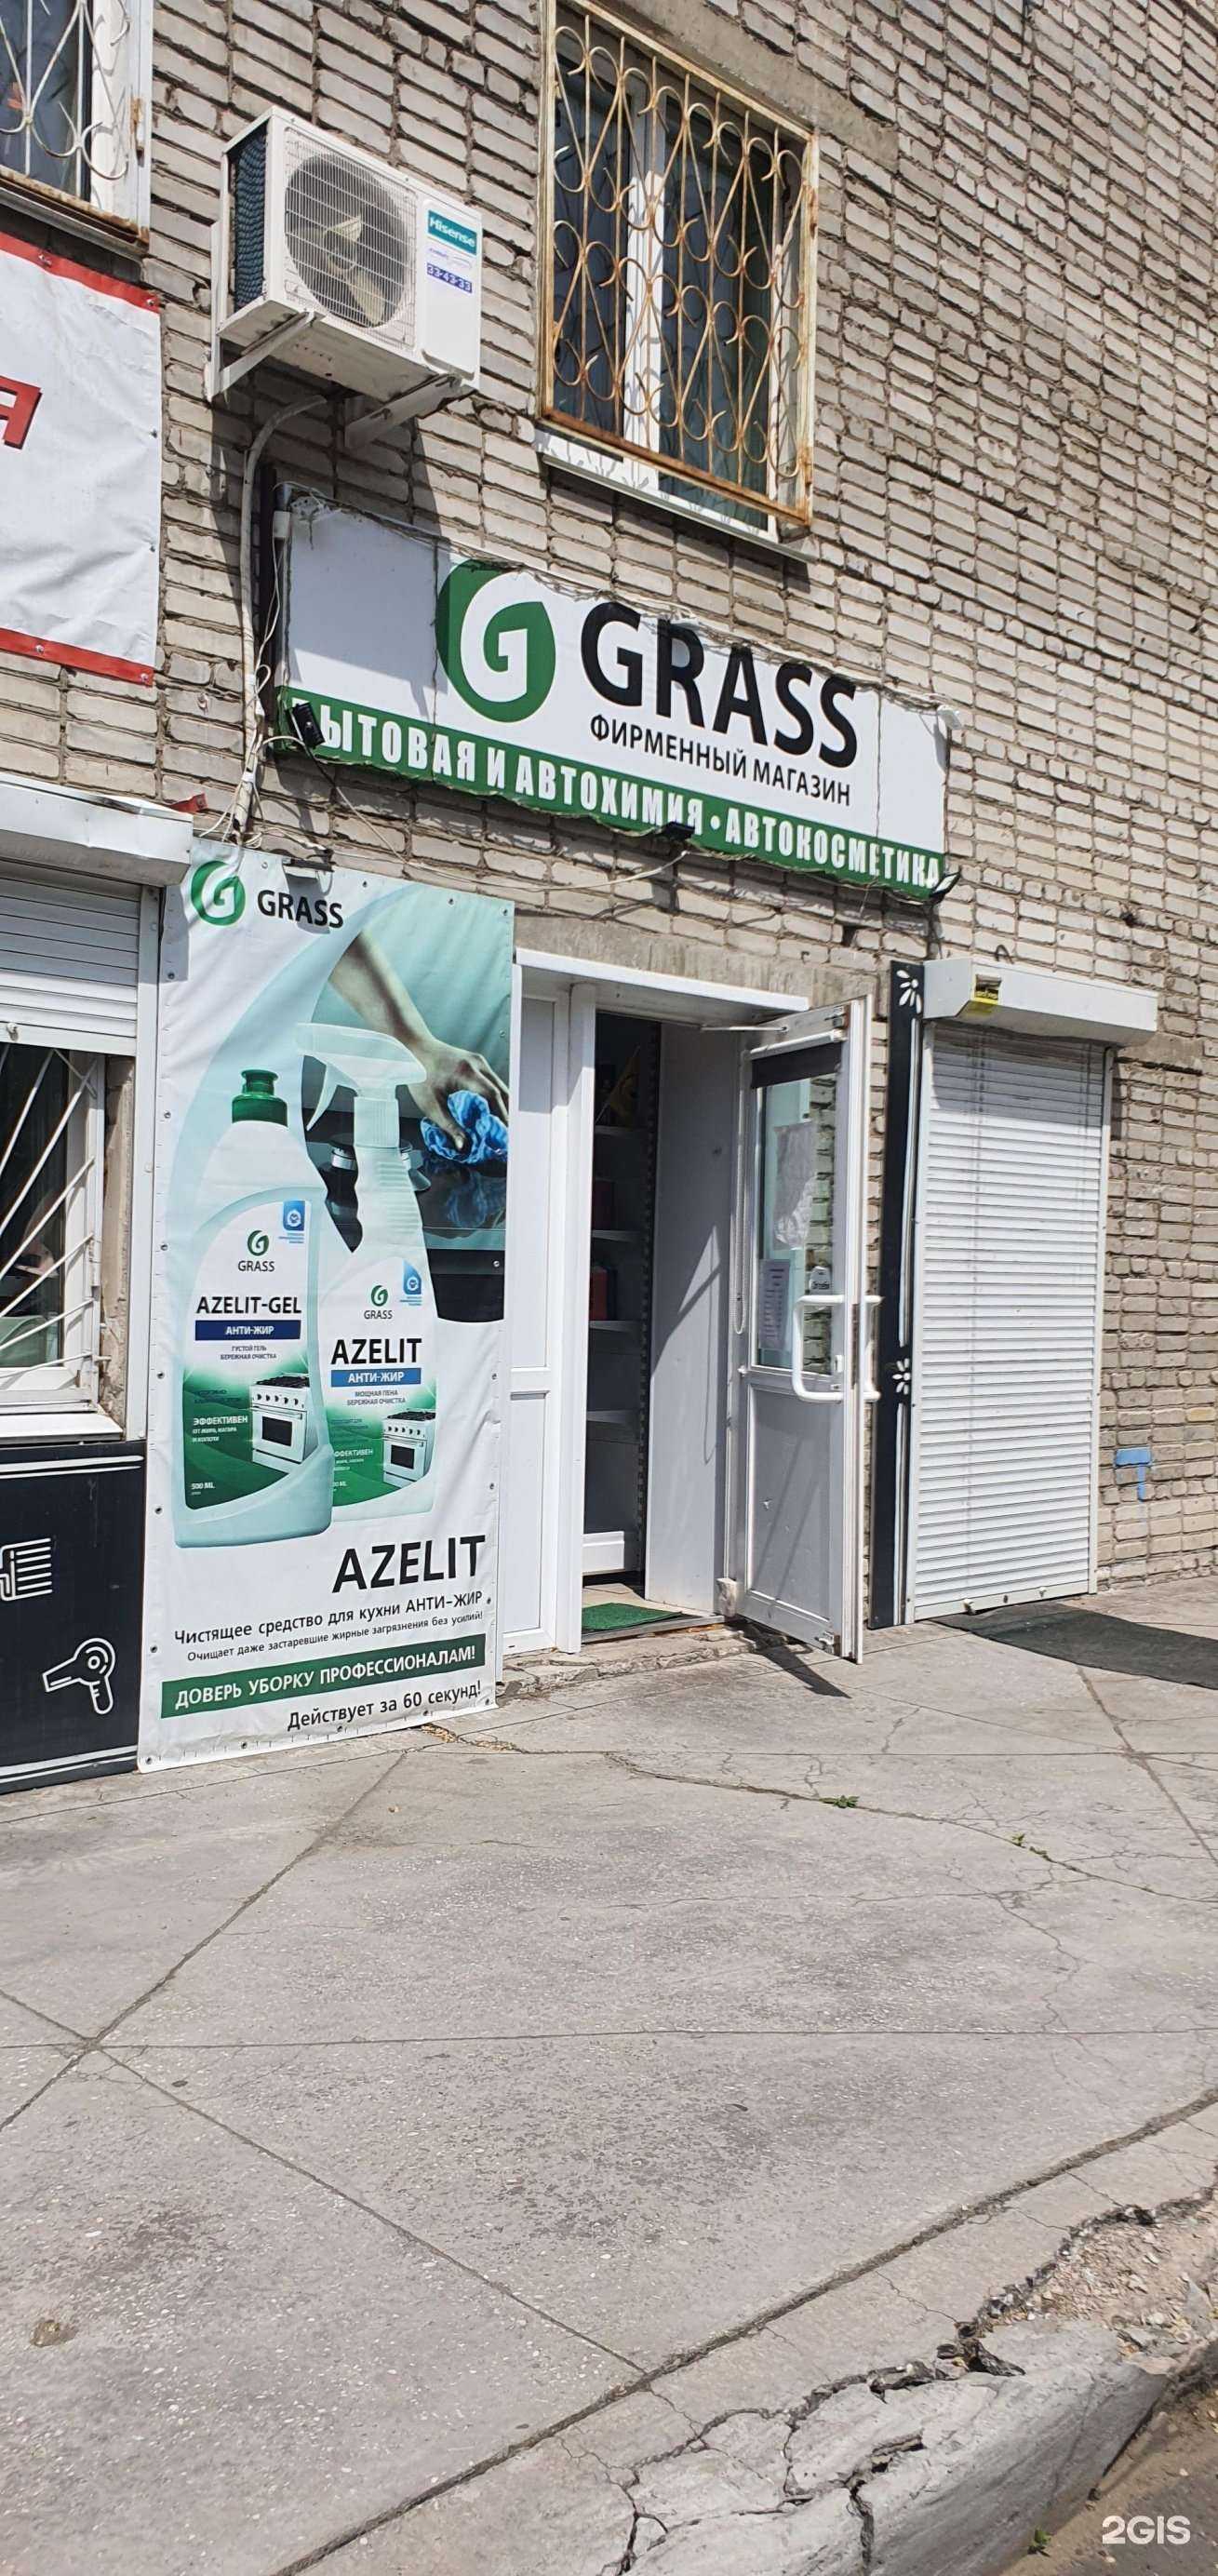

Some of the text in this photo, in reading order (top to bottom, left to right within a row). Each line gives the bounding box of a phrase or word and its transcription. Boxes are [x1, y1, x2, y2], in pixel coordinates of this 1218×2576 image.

[430, 216, 475, 248] Hisense
[581, 602, 858, 769] GRASS
[590, 713, 850, 807] ФИРМЕННЫЙ МАГАЗИН
[291, 696, 941, 889] ЫТОВАЯ И АВТОХИМИЯ АВТОКОСМЕТИКА
[257, 889, 344, 929] GRASS
[237, 1260, 275, 1272] GRASS
[196, 1296, 302, 1314] AZELIT-GEL
[364, 1309, 393, 1320] GRASS
[225, 1325, 274, 1335] АНТИ-ЖИР
[330, 1337, 422, 1365] AZELIT
[348, 1372, 405, 1383] АНТИ-ЖИР
[193, 1415, 248, 1426] ЭФФЕКТИВЕН
[331, 1535, 486, 1594] AZELIT
[174, 1590, 483, 1644] Чистящее средство для кухни АНТИ-ЖИР
[187, 1611, 483, 1661] Очищает даже застаревшие жирные загрязнения без усилий!
[175, 1645, 475, 1710] ДОВЕРЬ УБОРКУ ПРОФЕССИОНАЛАМ!
[288, 1679, 482, 1732] Действует за 60 секунд!
